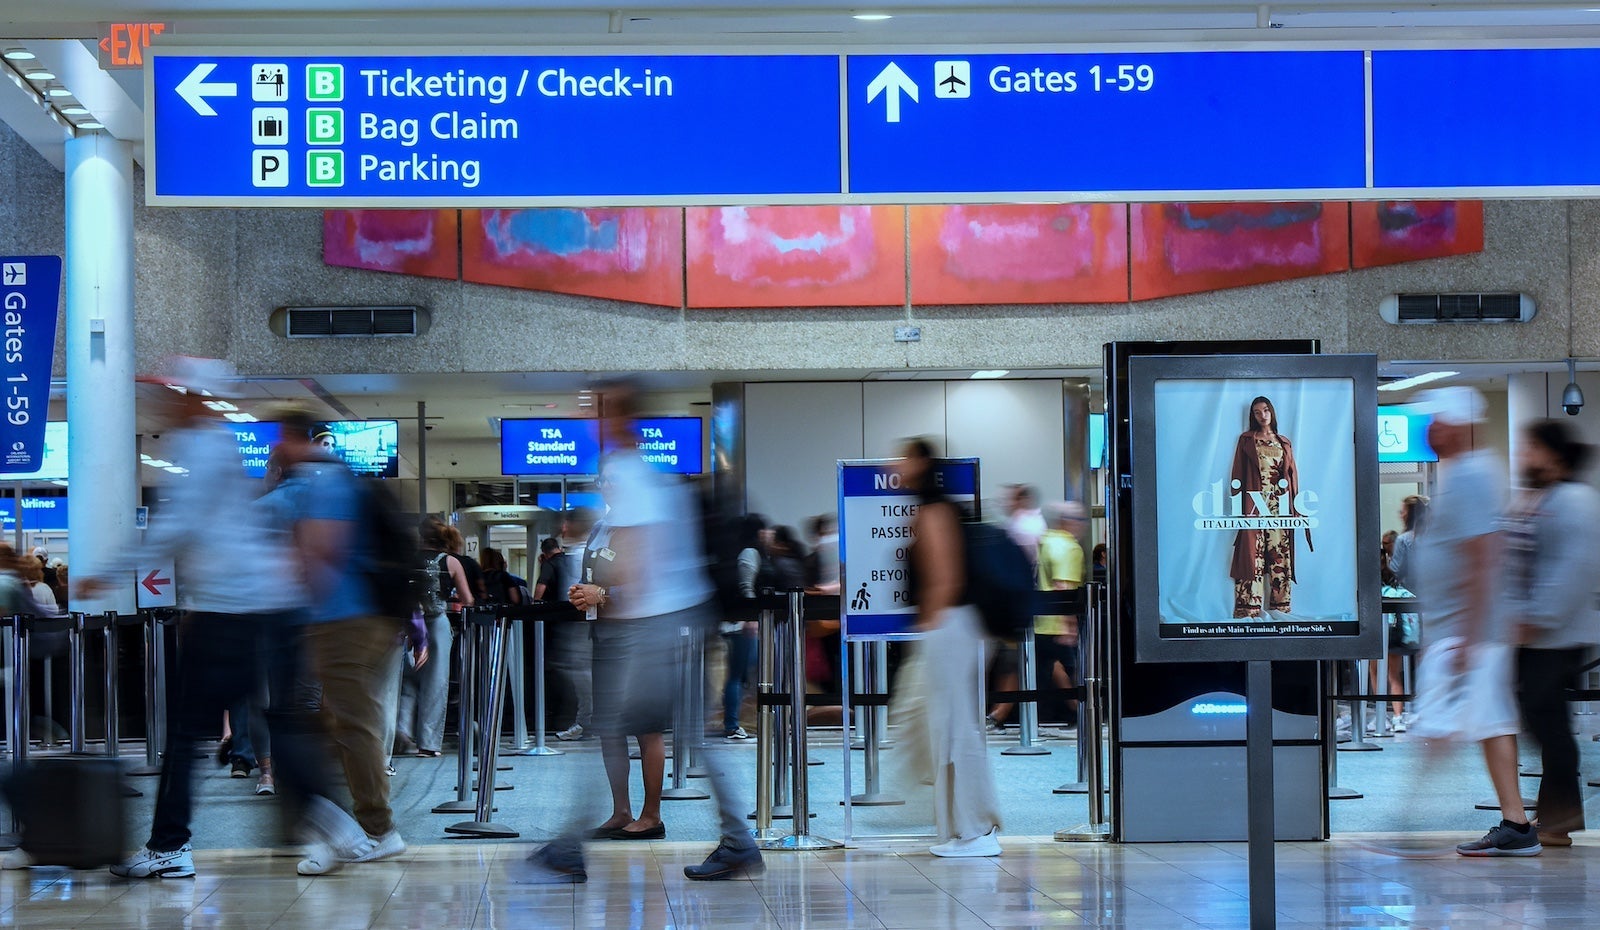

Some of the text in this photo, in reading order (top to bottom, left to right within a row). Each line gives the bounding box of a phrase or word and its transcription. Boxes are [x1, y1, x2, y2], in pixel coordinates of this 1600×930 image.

[988, 64, 1155, 93] Gates 1-59
[314, 69, 673, 104] B Ticketing / Check-in
[314, 111, 518, 146] B Bag Claim
[315, 156, 336, 180] B
[360, 153, 481, 188] Parking
[4, 292, 26, 363] Gates
[6, 373, 30, 425] 1-59
[235, 432, 257, 441] TSA
[540, 428, 563, 438] TSA
[641, 428, 663, 438] TSA
[238, 444, 270, 455] ndard
[528, 440, 576, 451] Standard
[526, 453, 578, 466] Screening
[1192, 478, 1319, 517] dixie
[1203, 519, 1311, 529] ITALIAN FASHION
[871, 526, 918, 538] PASSEN
[467, 541, 478, 552] 17
[1182, 626, 1200, 634] Find
[1215, 625, 1227, 633] the
[1227, 625, 1245, 633] Main
[1291, 624, 1311, 632] Floor
[1310, 624, 1327, 632] Side
